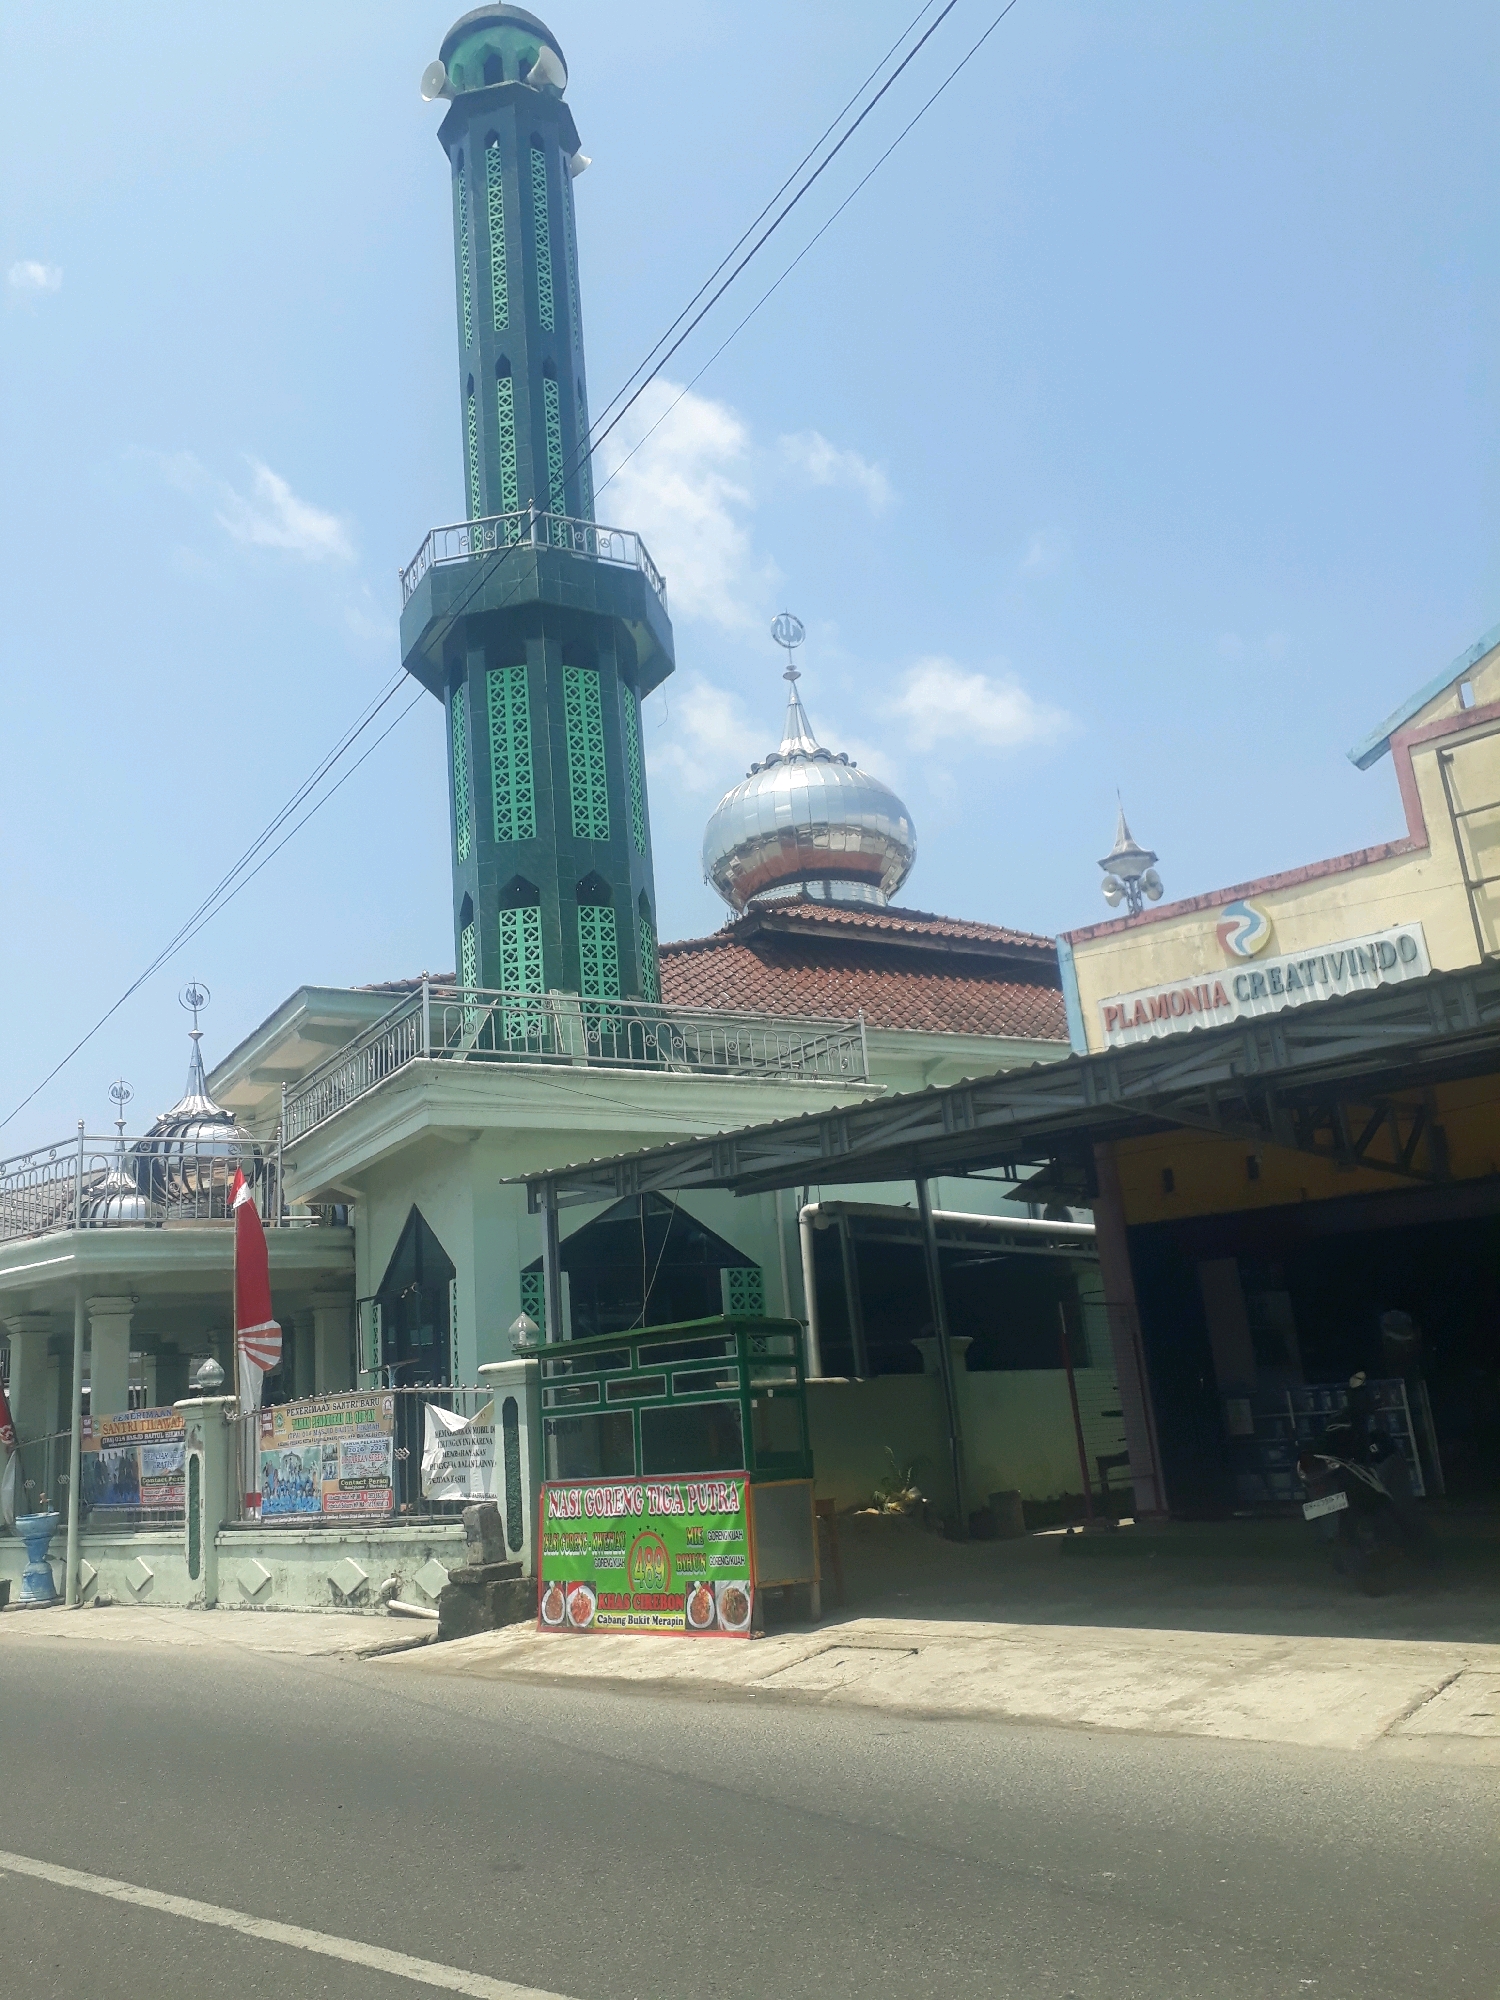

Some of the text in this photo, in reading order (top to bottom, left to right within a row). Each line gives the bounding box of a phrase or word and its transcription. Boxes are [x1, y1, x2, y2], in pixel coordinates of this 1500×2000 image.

[1104, 933, 1418, 1032] PLAMONIA CREATIVINDO
[113, 1410, 172, 1422] PENERIMAAN
[286, 1397, 380, 1417] PENERIMAAN SANTRI BARU
[103, 1419, 137, 1434] SANTRI
[141, 1416, 185, 1431] TILAWAH
[471, 1437, 493, 1446] KARENA
[548, 1480, 741, 1518] NASI GORENG TIGA PUTRA
[543, 1532, 561, 1556] NASI
[561, 1533, 587, 1556] GORENG
[686, 1526, 704, 1548] MIE
[633, 1546, 666, 1590] 489
[676, 1553, 707, 1575] BIHUN
[597, 1593, 684, 1611] KHAS CIREBON
[597, 1613, 684, 1629] Cabang Bukit Merapin
